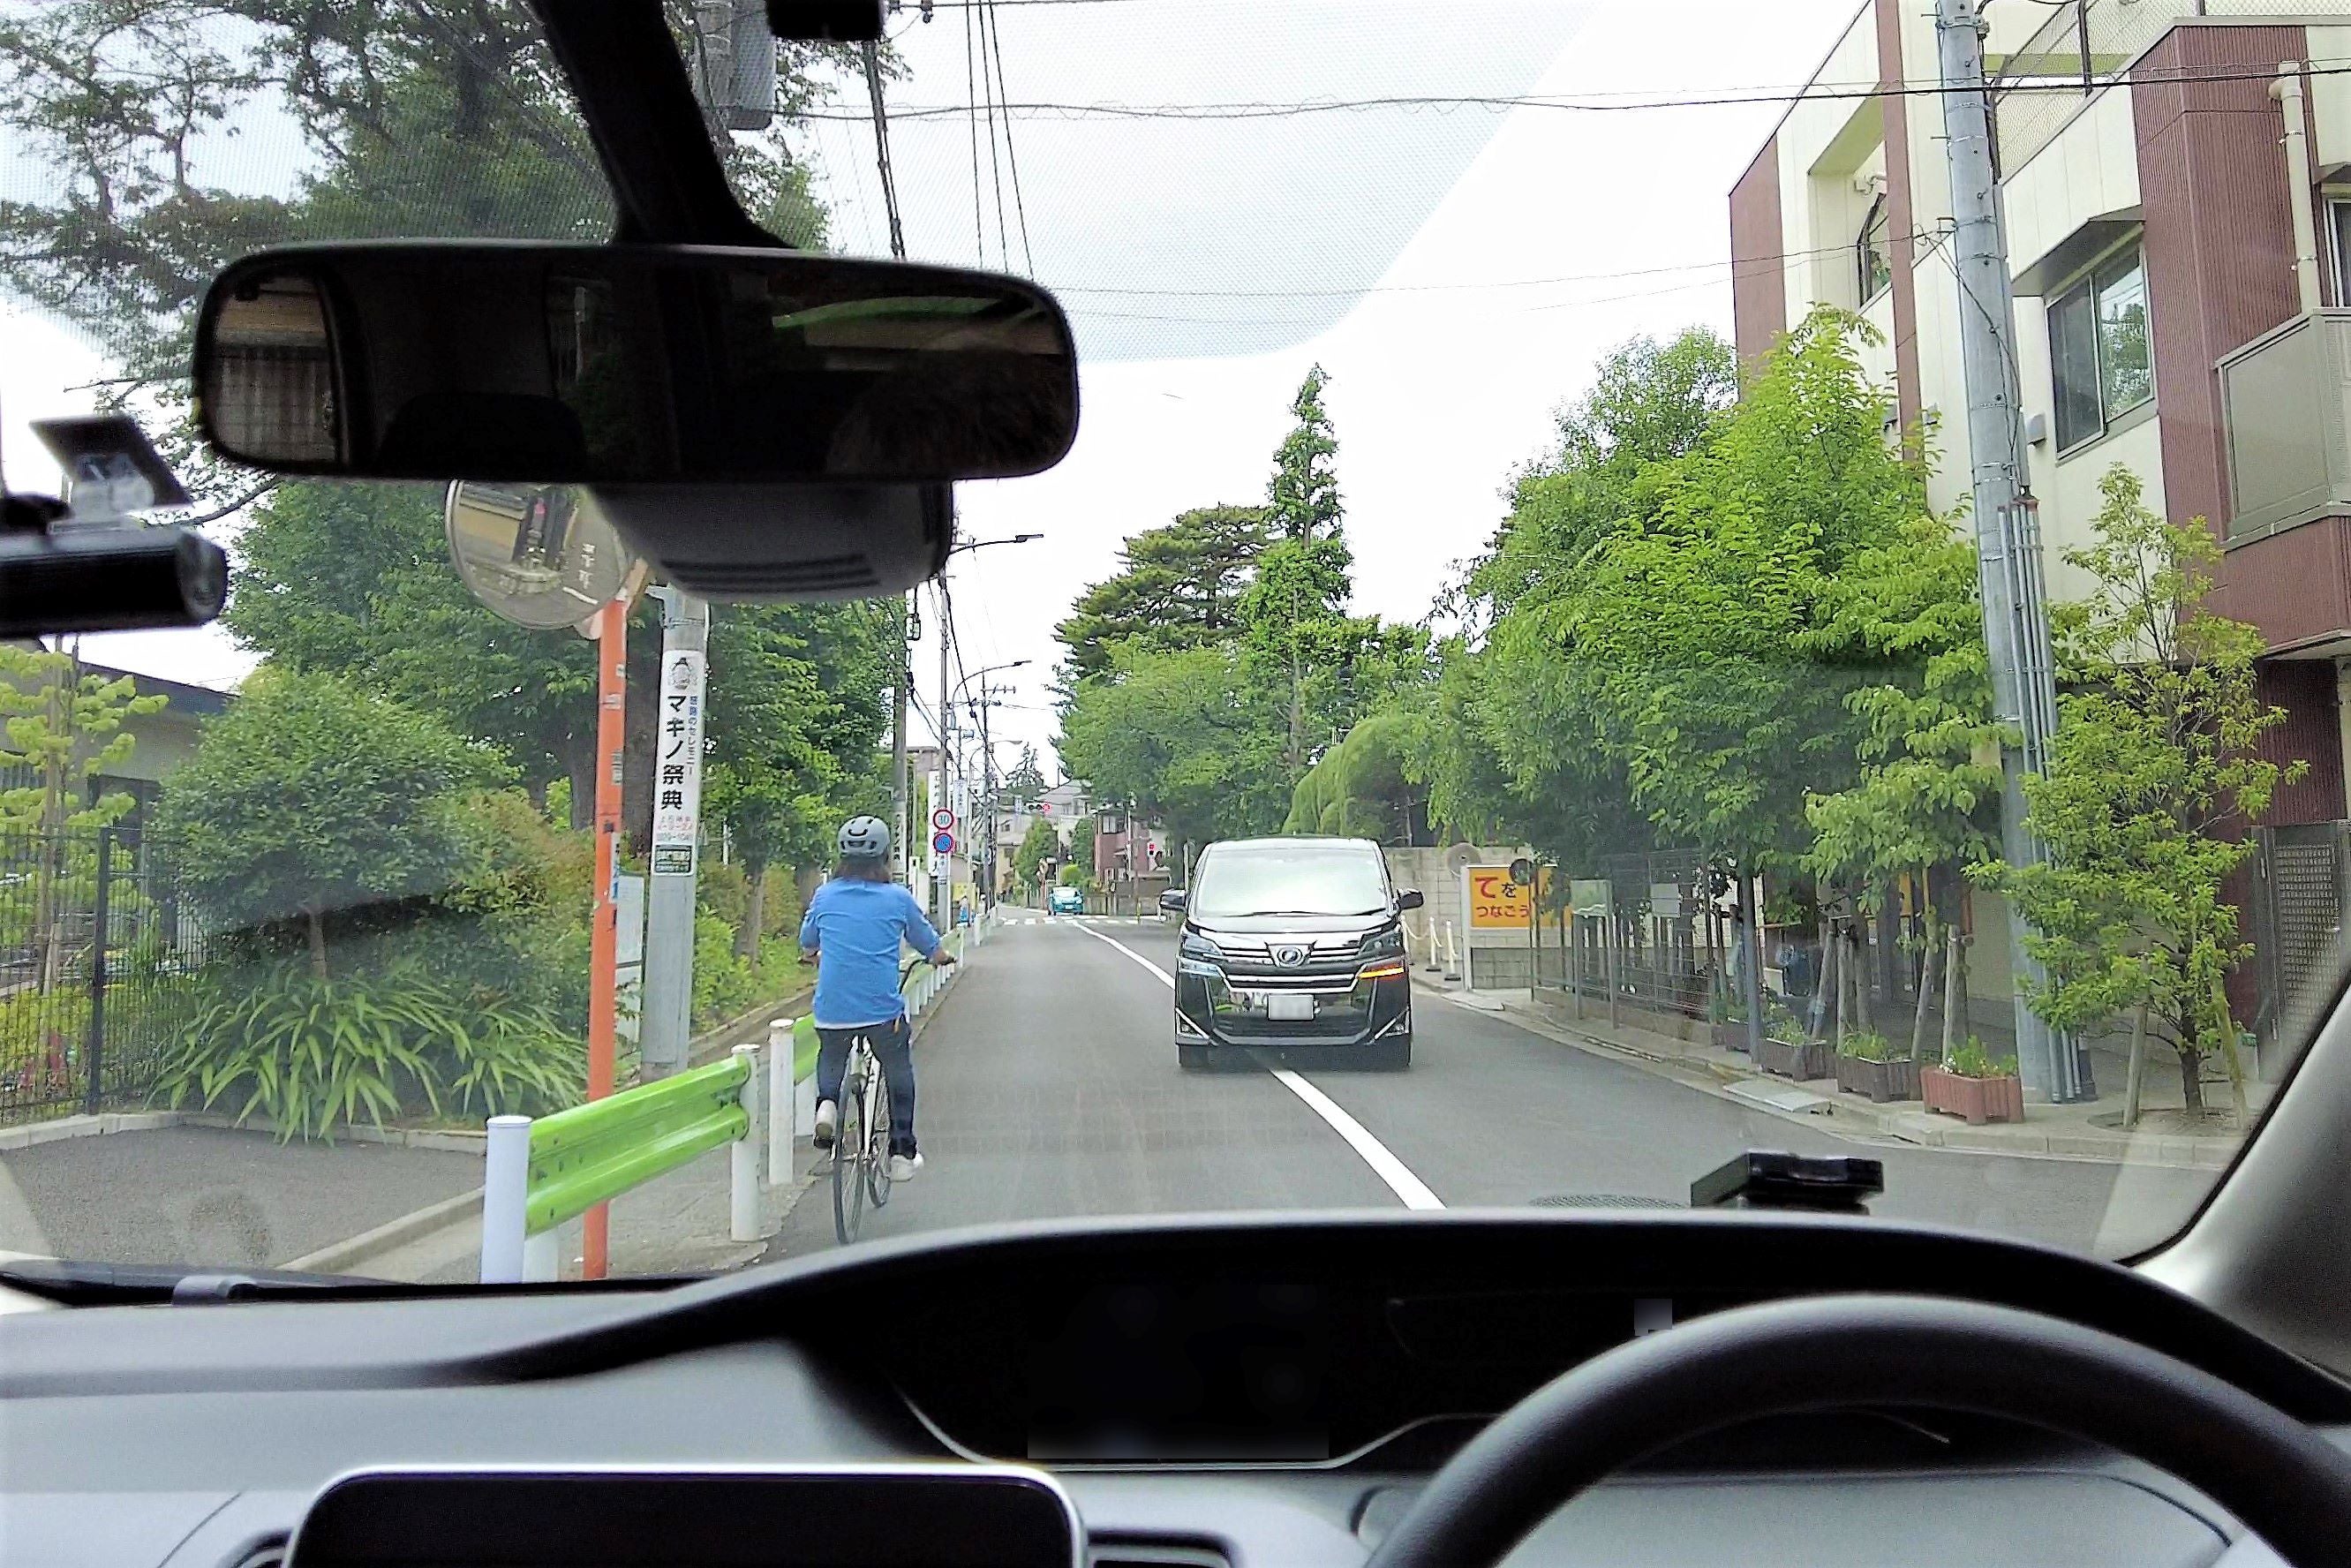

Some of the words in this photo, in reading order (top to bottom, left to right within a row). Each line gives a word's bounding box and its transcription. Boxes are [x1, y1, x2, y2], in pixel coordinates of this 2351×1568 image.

[661, 695, 687, 810] マキノ祭典
[938, 815, 950, 825] 30
[1474, 876, 1517, 899] てを
